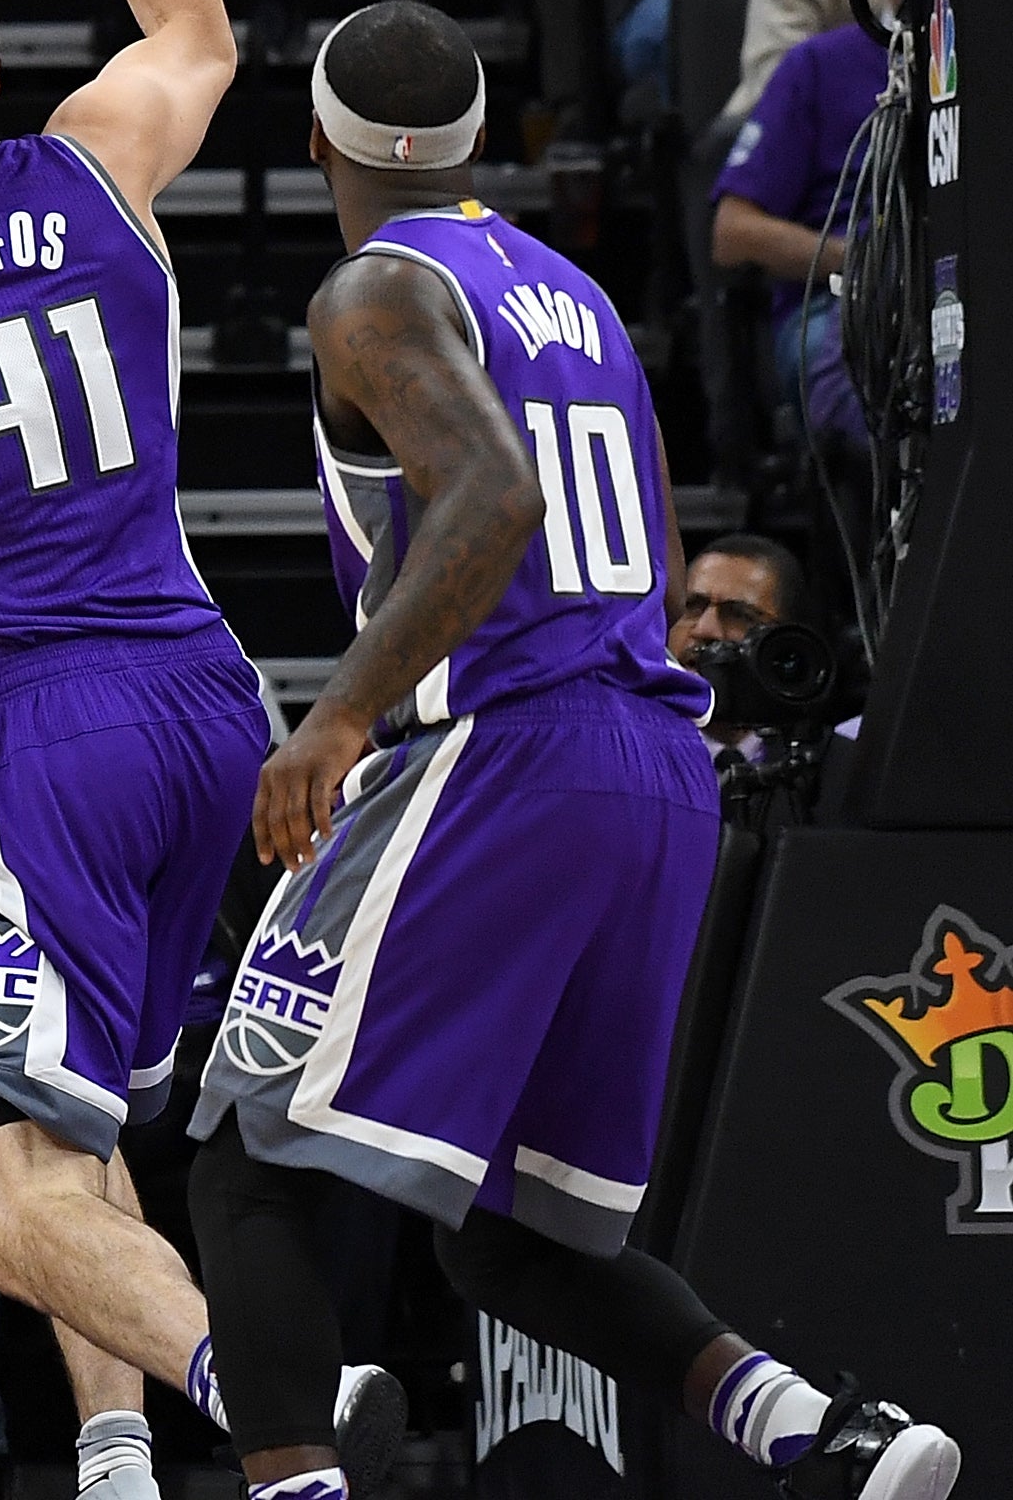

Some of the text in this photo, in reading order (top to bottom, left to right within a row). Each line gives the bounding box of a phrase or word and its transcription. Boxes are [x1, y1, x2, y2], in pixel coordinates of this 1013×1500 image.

[927, 105, 961, 188] CSN
[522, 400, 654, 595] 10
[233, 975, 331, 1031] SAC
